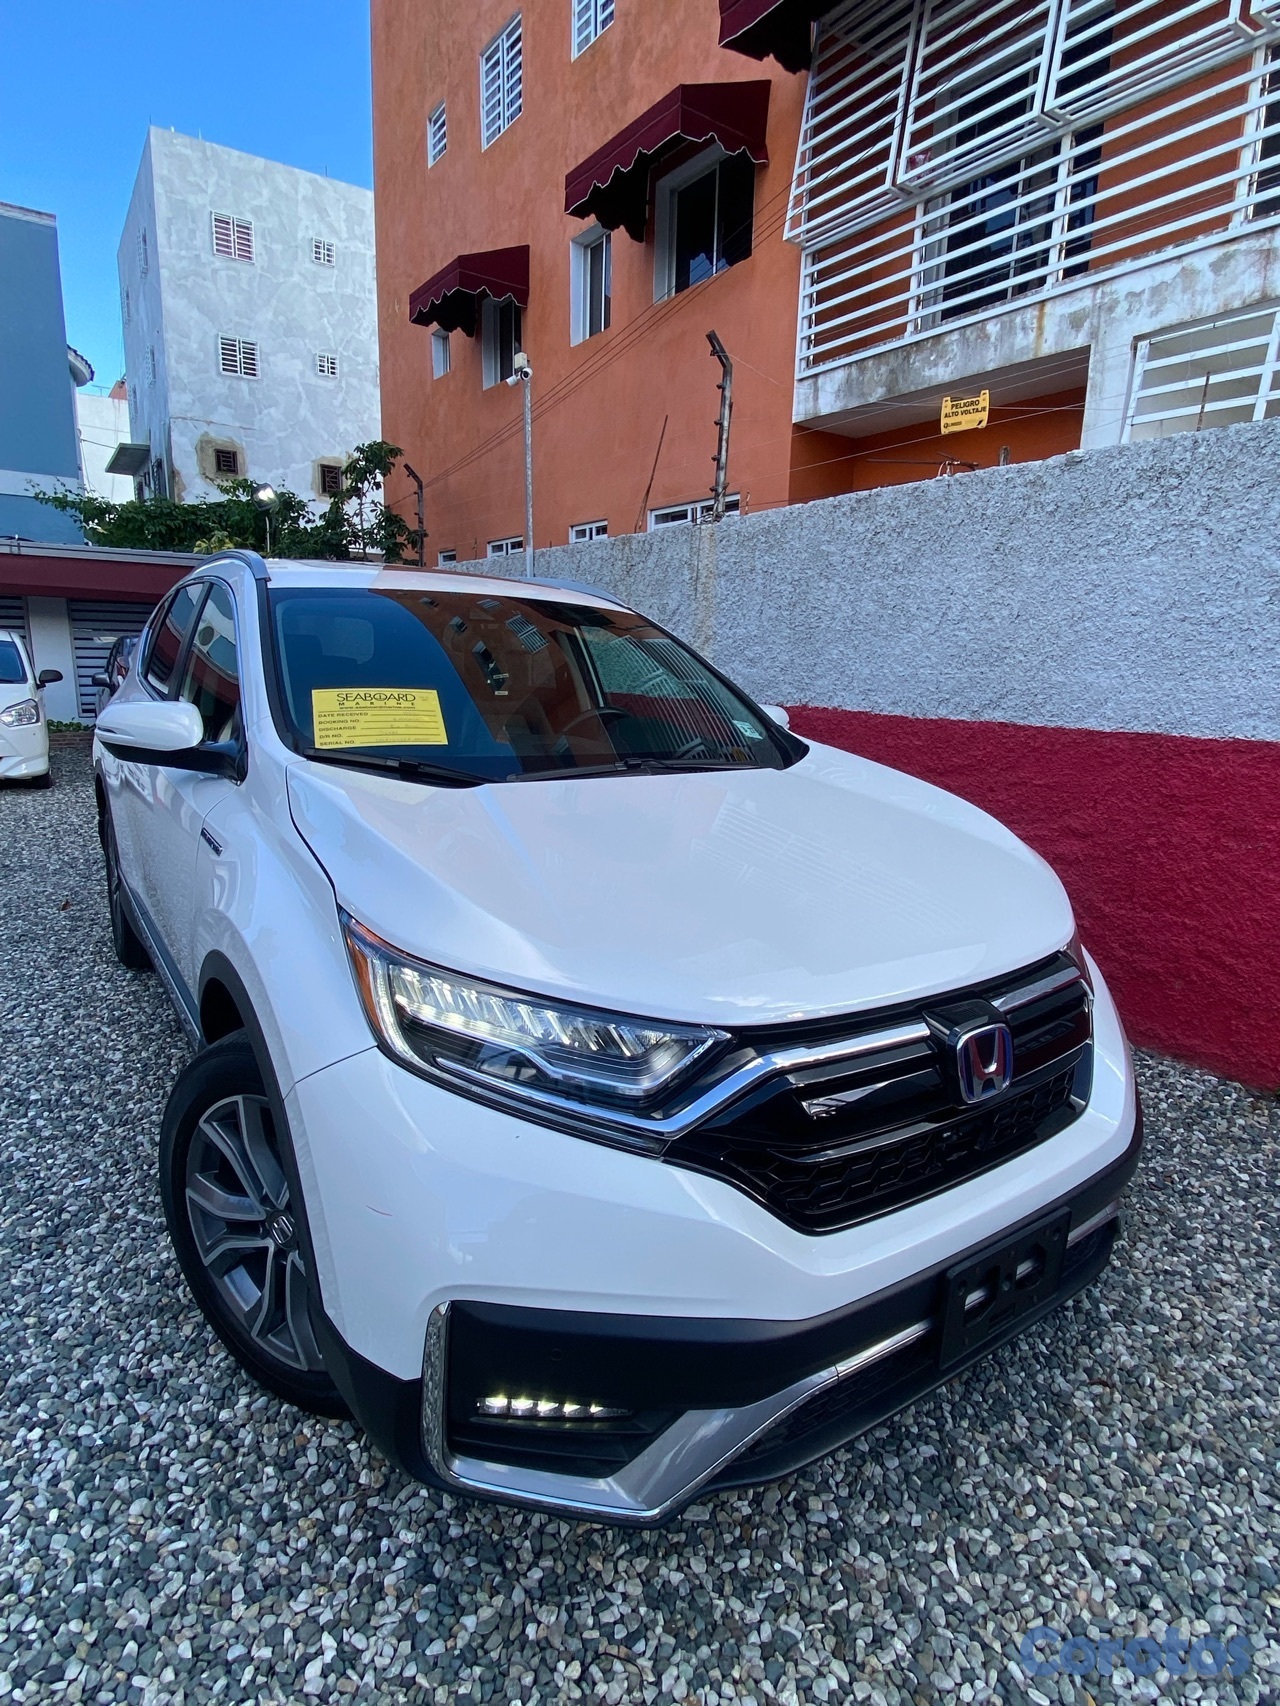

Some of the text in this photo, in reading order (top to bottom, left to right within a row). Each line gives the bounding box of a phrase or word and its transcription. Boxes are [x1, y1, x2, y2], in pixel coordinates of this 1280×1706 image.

[951, 400, 980, 410] PELIGRO
[961, 406, 987, 416] VOLTAJE
[337, 693, 416, 702] SEABOARD
